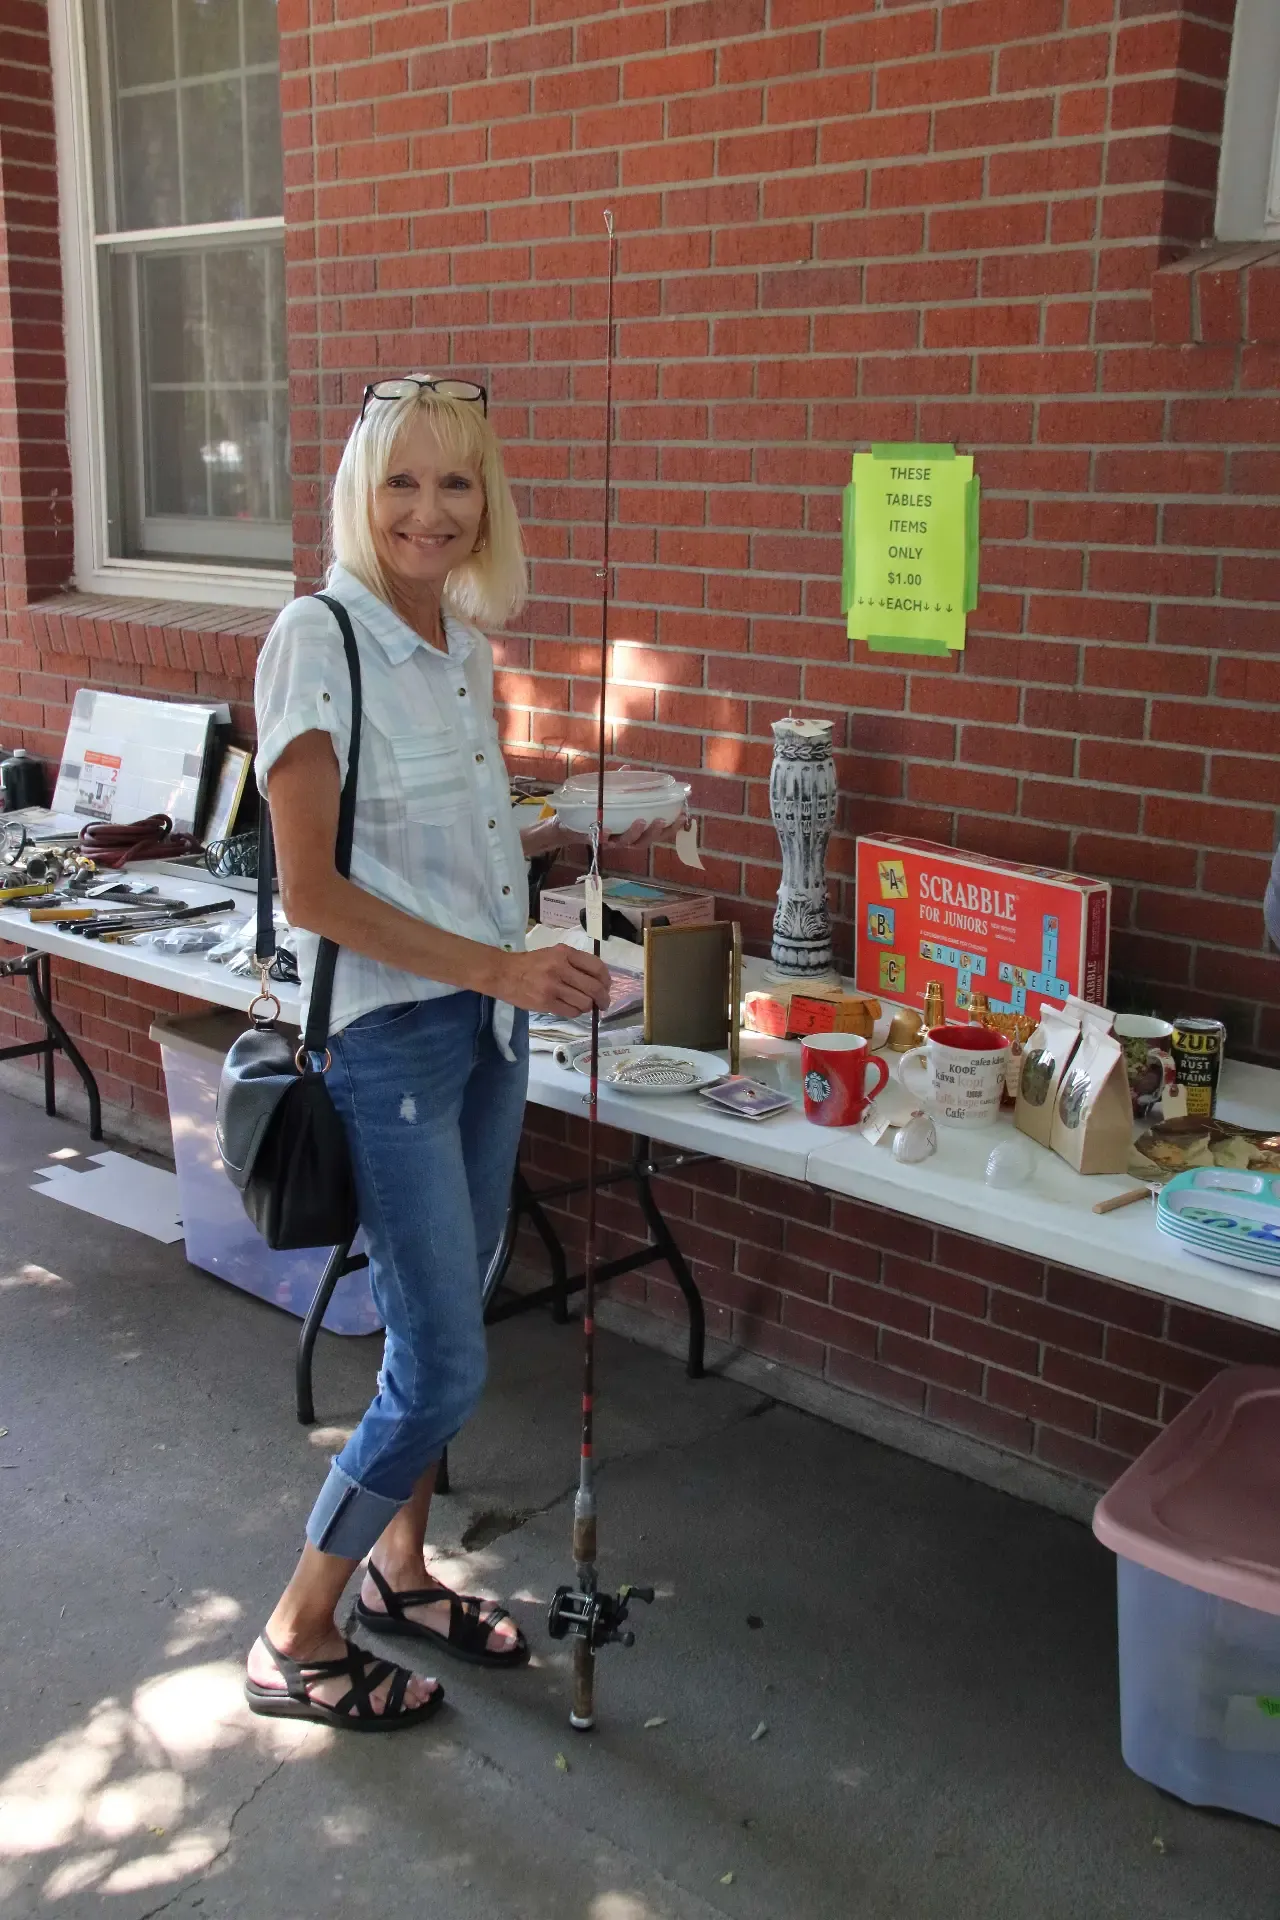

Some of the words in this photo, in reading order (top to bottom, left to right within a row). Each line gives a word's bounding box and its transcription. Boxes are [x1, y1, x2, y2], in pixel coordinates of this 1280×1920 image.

[890, 467, 931, 480] THESE
[886, 493, 932, 507] TABLES
[889, 520, 927, 534] ITEMS
[888, 546, 923, 560] ONLY
[887, 572, 922, 585] $1.00
[886, 598, 922, 612] EACH
[111, 769, 118, 782] 2
[889, 868, 899, 890] A
[919, 872, 1017, 921] SCRABBLE
[877, 914, 886, 936] B
[919, 904, 940, 923] FOR
[943, 910, 989, 936] JUNIORS
[887, 961, 898, 984] C
[1086, 960, 1097, 1002] RABBLE
[1177, 1032, 1217, 1051] ZUD
[949, 1064, 976, 1076] КОФЕ
[1181, 1060, 1210, 1070] RUST
[935, 1069, 955, 1084] káva
[1177, 1072, 1212, 1082] STAINS
[945, 1107, 965, 1119] Café
